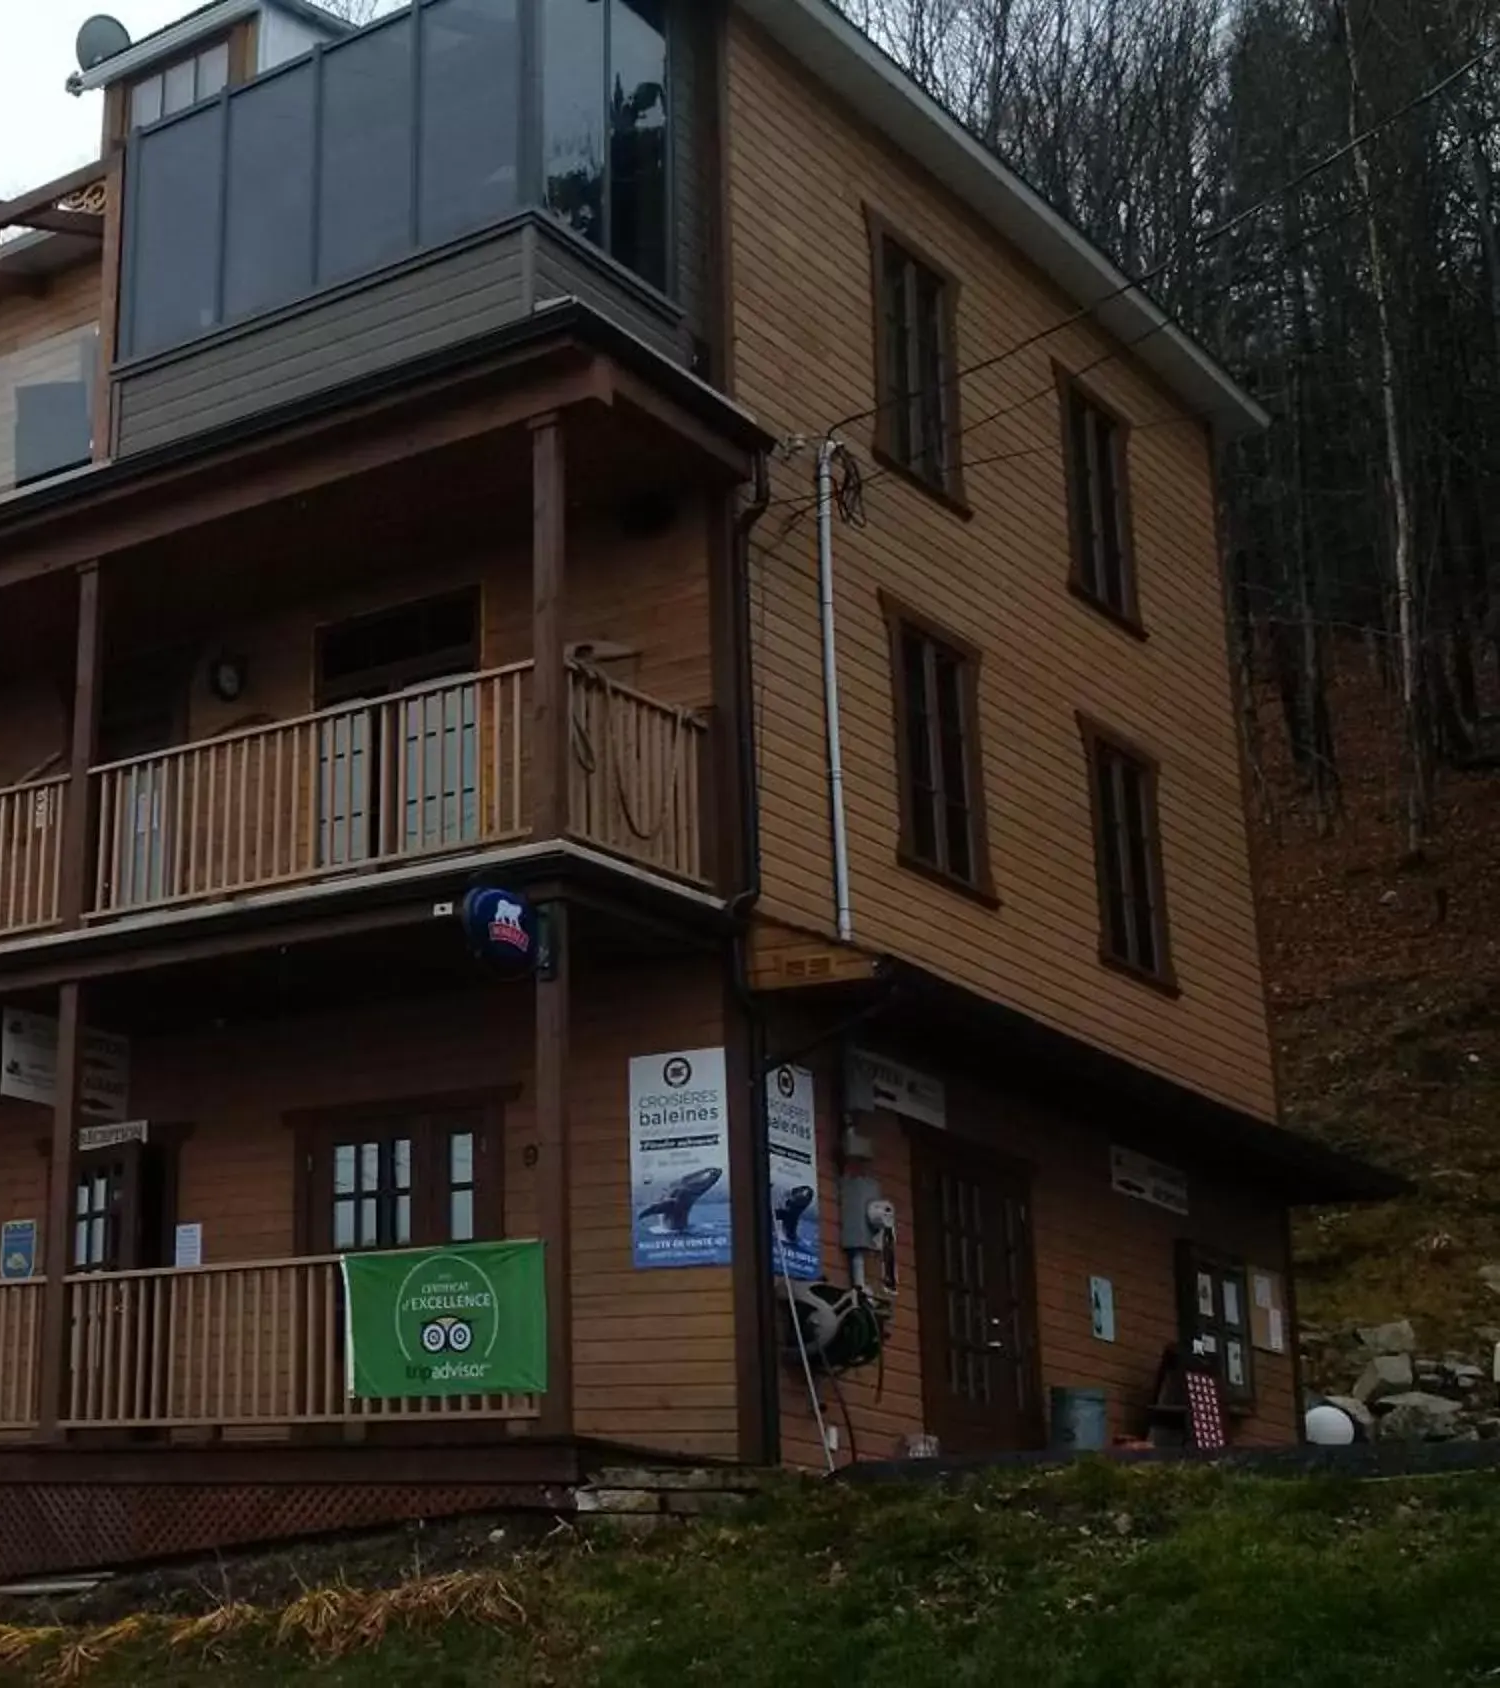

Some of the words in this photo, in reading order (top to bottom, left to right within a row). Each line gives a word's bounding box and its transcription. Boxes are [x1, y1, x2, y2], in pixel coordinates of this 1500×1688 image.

[638, 1089, 718, 1109] CROISIÈRES
[639, 1107, 719, 1127] baleines
[421, 1281, 469, 1294] CERTIFICAT
[405, 1361, 485, 1384] tripadvisor
